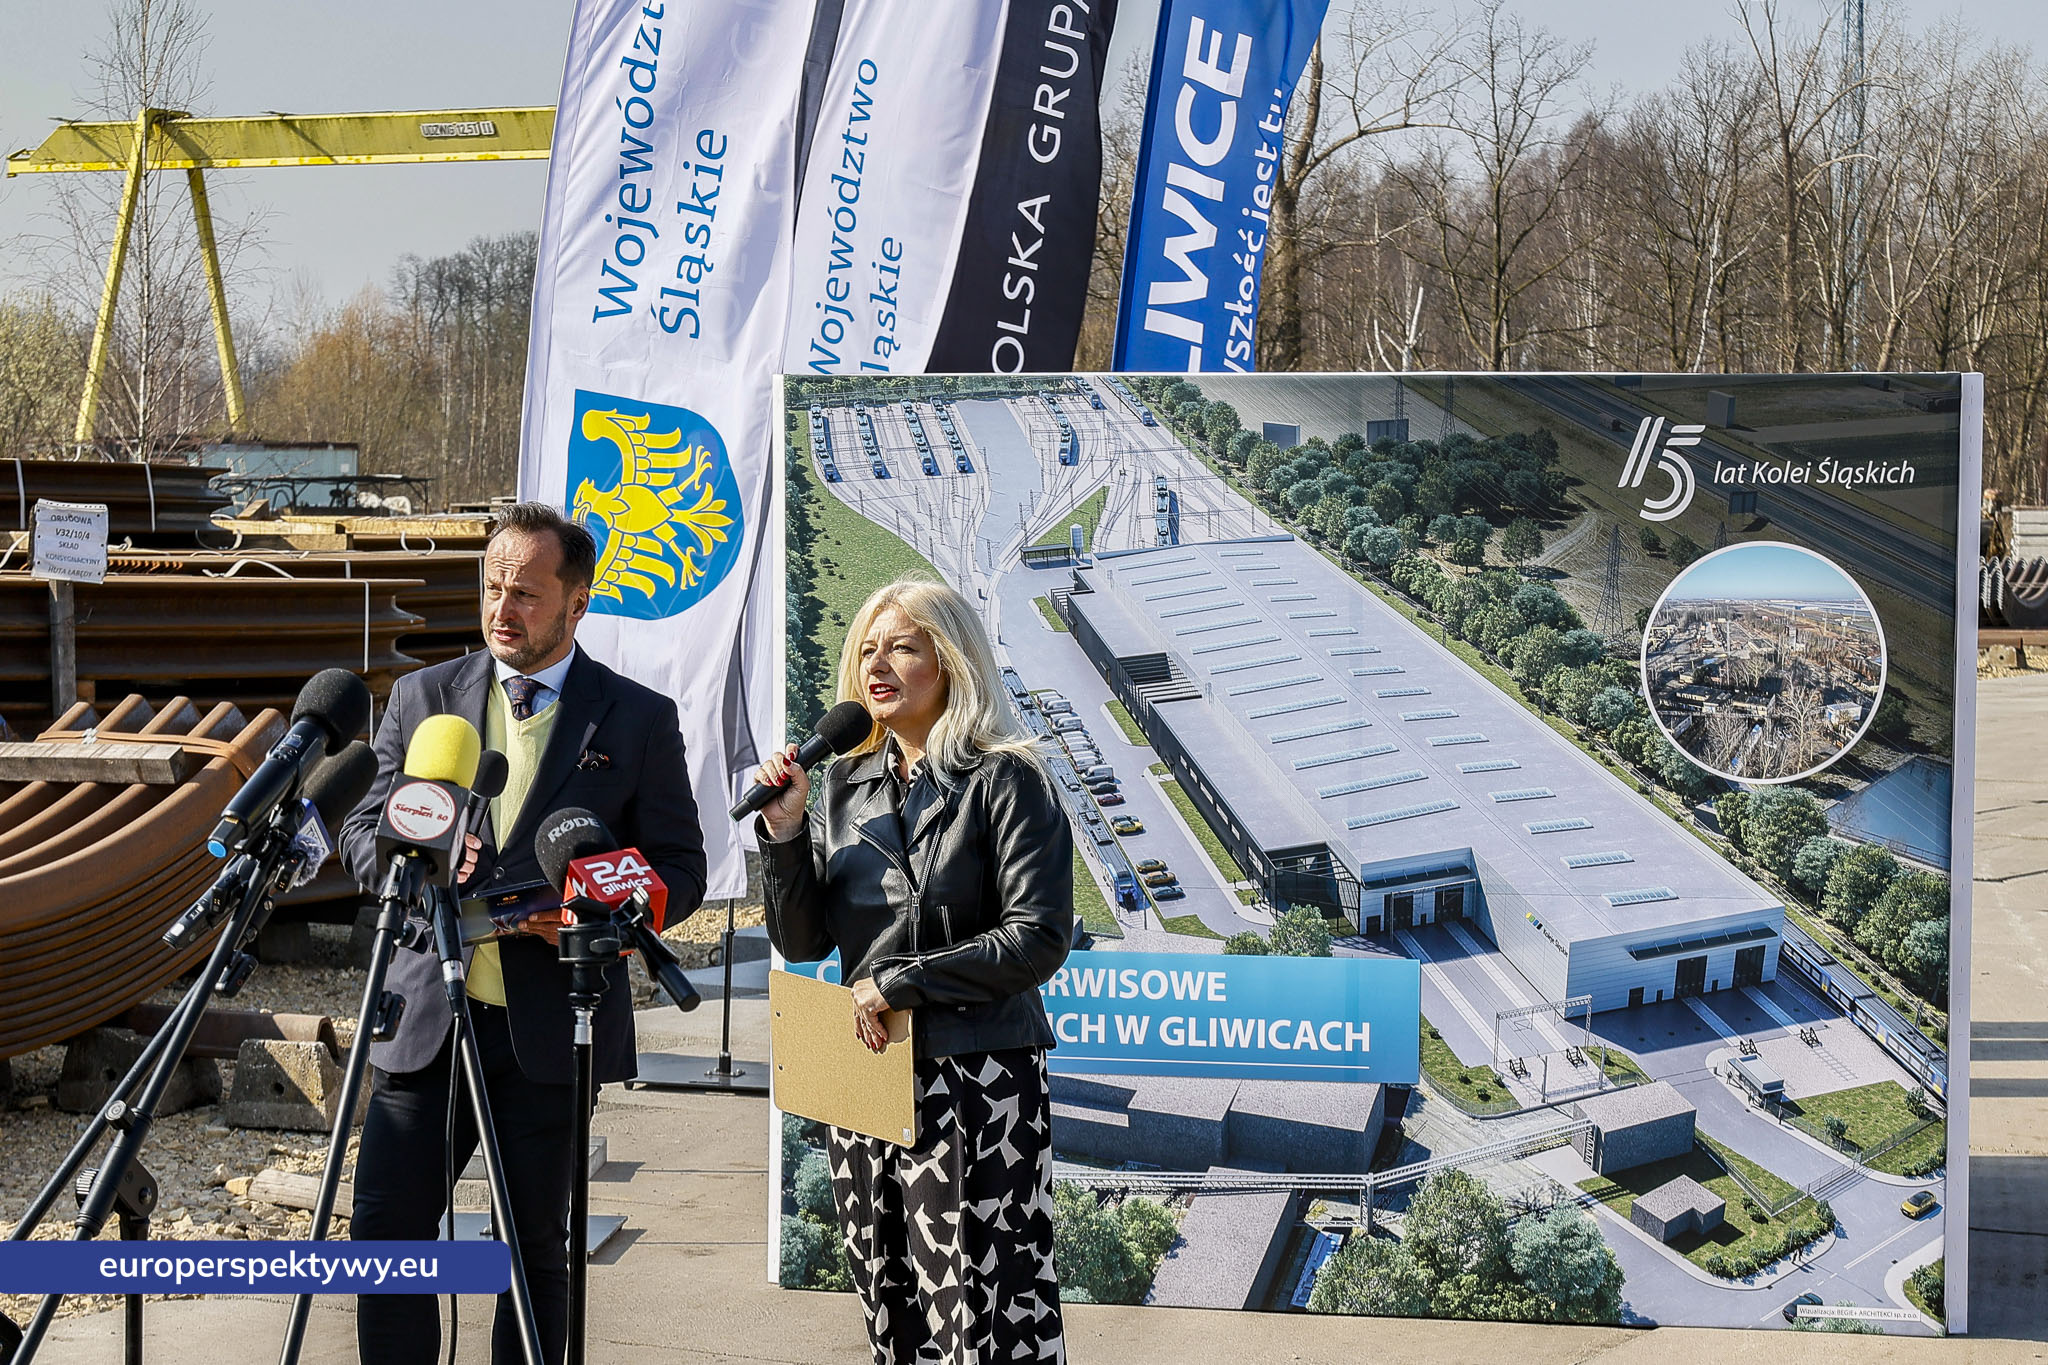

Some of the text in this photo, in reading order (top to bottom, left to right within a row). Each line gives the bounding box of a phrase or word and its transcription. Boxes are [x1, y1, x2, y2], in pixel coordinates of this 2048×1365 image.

[592, 0, 665, 324] Województ
[1143, 16, 1253, 373] IWICE
[1241, 141, 1278, 229] jest
[649, 128, 728, 340] Śląskie
[808, 58, 879, 375] Województwo
[860, 236, 903, 374] ląskie
[991, 193, 1051, 373] OLSKA
[1617, 416, 1916, 522] 15 lat Kolei Śląskich
[55, 528, 91, 541] V32/10/4
[58, 541, 79, 551] SKŁAD
[547, 817, 601, 843] RØDE
[584, 855, 652, 885] 24
[601, 877, 653, 896] gliwice
[1040, 967, 1227, 1002] RWISOWE
[1114, 1014, 1150, 1045] W
[1159, 1015, 1371, 1052] GLIWICACH
